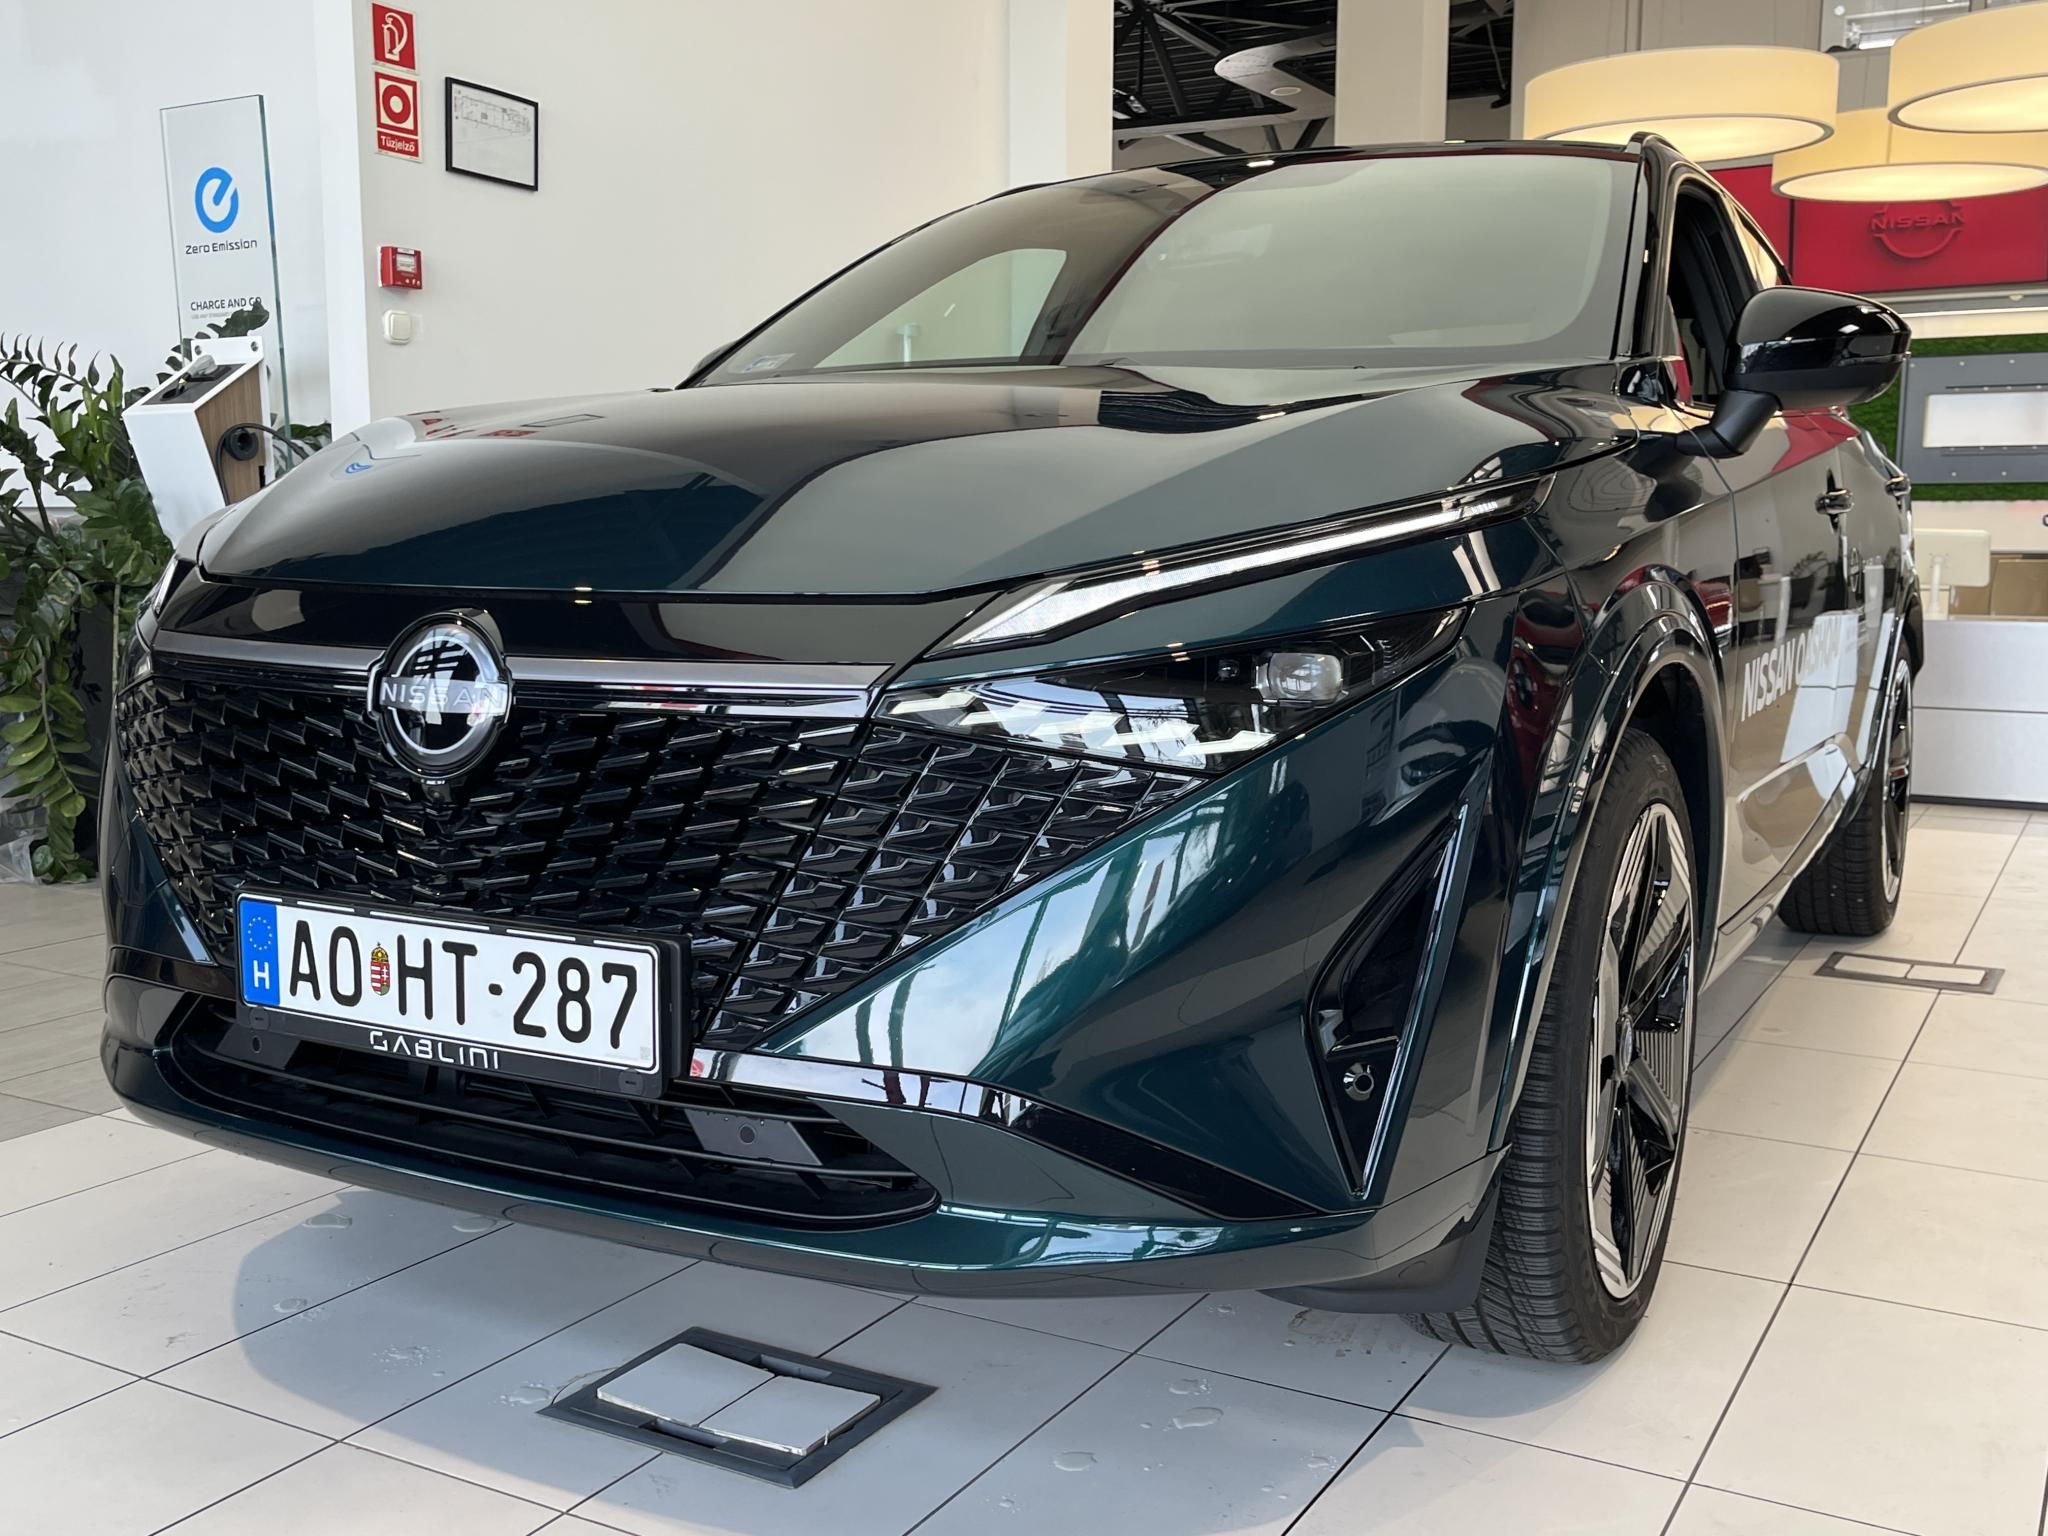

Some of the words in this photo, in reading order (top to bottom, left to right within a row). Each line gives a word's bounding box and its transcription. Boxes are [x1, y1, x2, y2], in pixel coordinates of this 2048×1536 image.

[1871, 211, 1964, 230] NISSAN
[185, 244, 210, 255] Zero
[212, 239, 258, 252] Emission
[190, 299, 226, 311] CHARGE
[227, 298, 247, 308] AND
[1741, 638, 1796, 721] NISSAN
[381, 681, 506, 710] NISSAN
[252, 959, 271, 990] H
[369, 1030, 499, 1069] GABLINI
